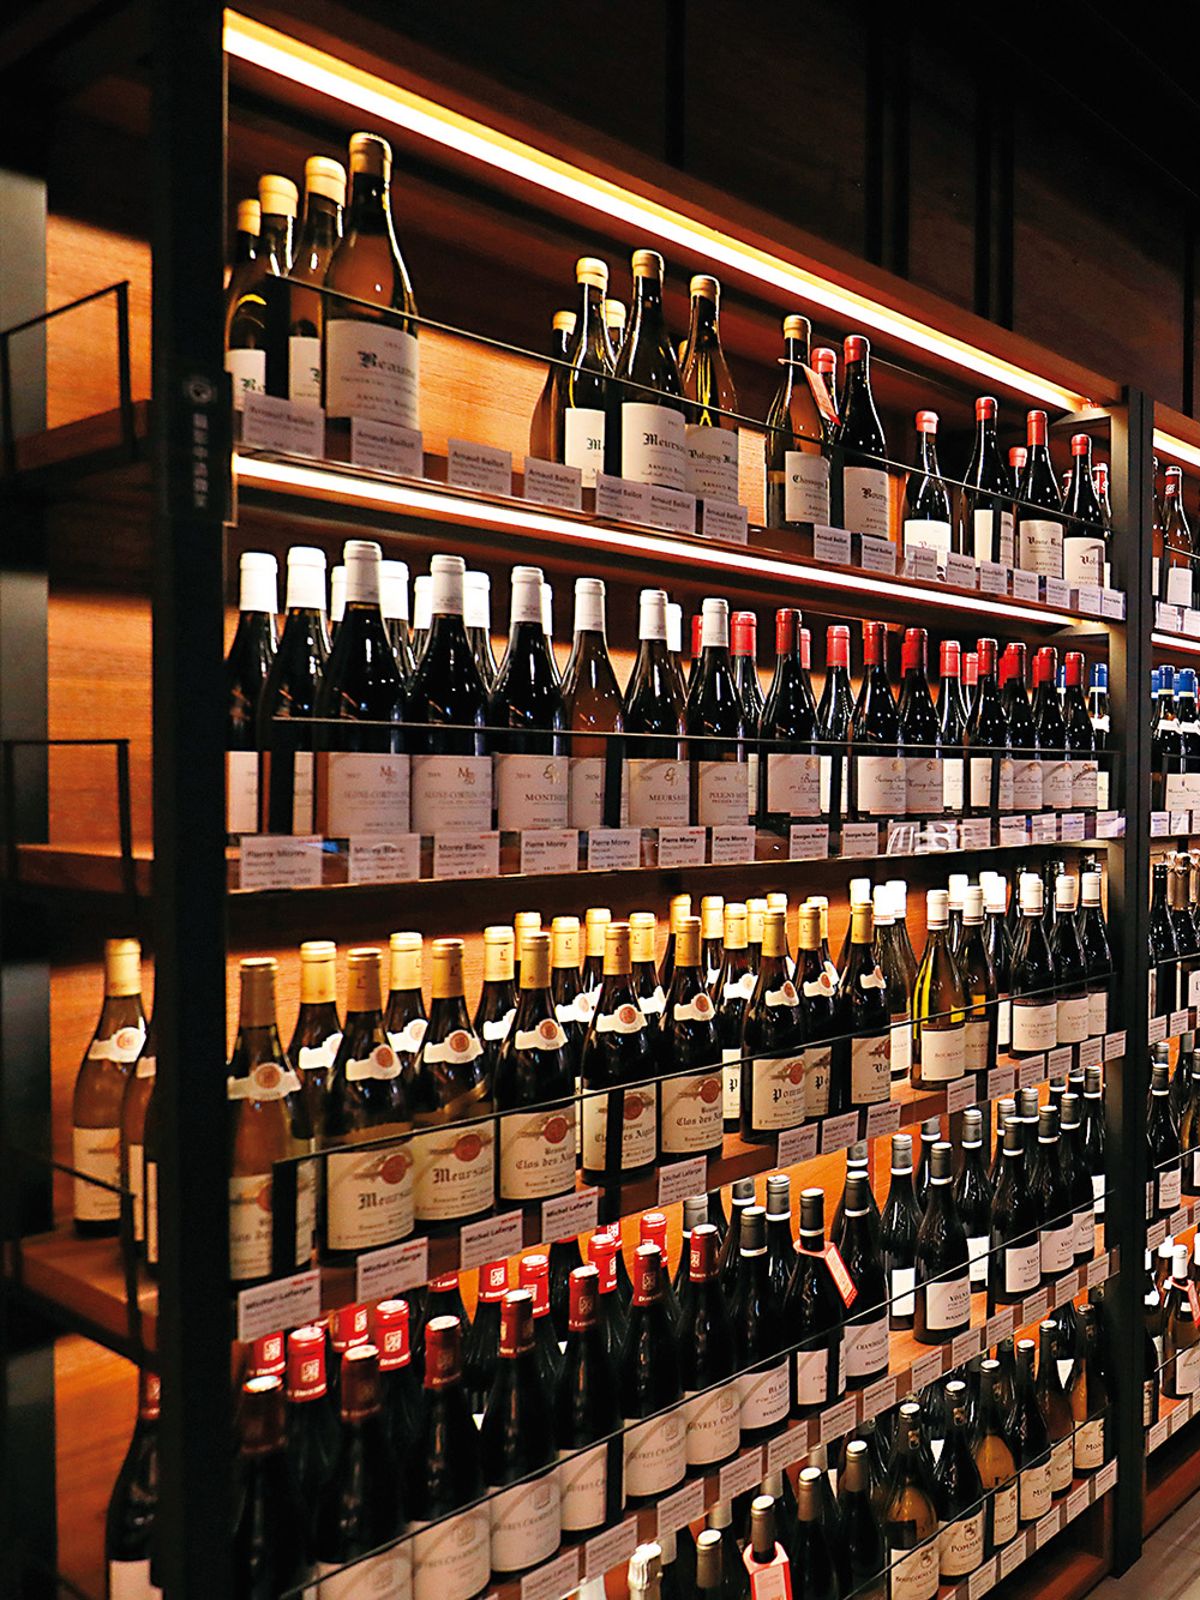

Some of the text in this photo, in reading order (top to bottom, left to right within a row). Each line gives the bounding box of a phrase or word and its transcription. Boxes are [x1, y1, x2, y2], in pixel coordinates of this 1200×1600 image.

[525, 840, 568, 849] Pierre Morey
[592, 839, 631, 848] Pierre Morey
[679, 837, 698, 845] Morey
[438, 842, 485, 853] Morey Blanc
[662, 1173, 681, 1182] Michel
[546, 1206, 568, 1218] Michel
[465, 1232, 489, 1243] Michel
